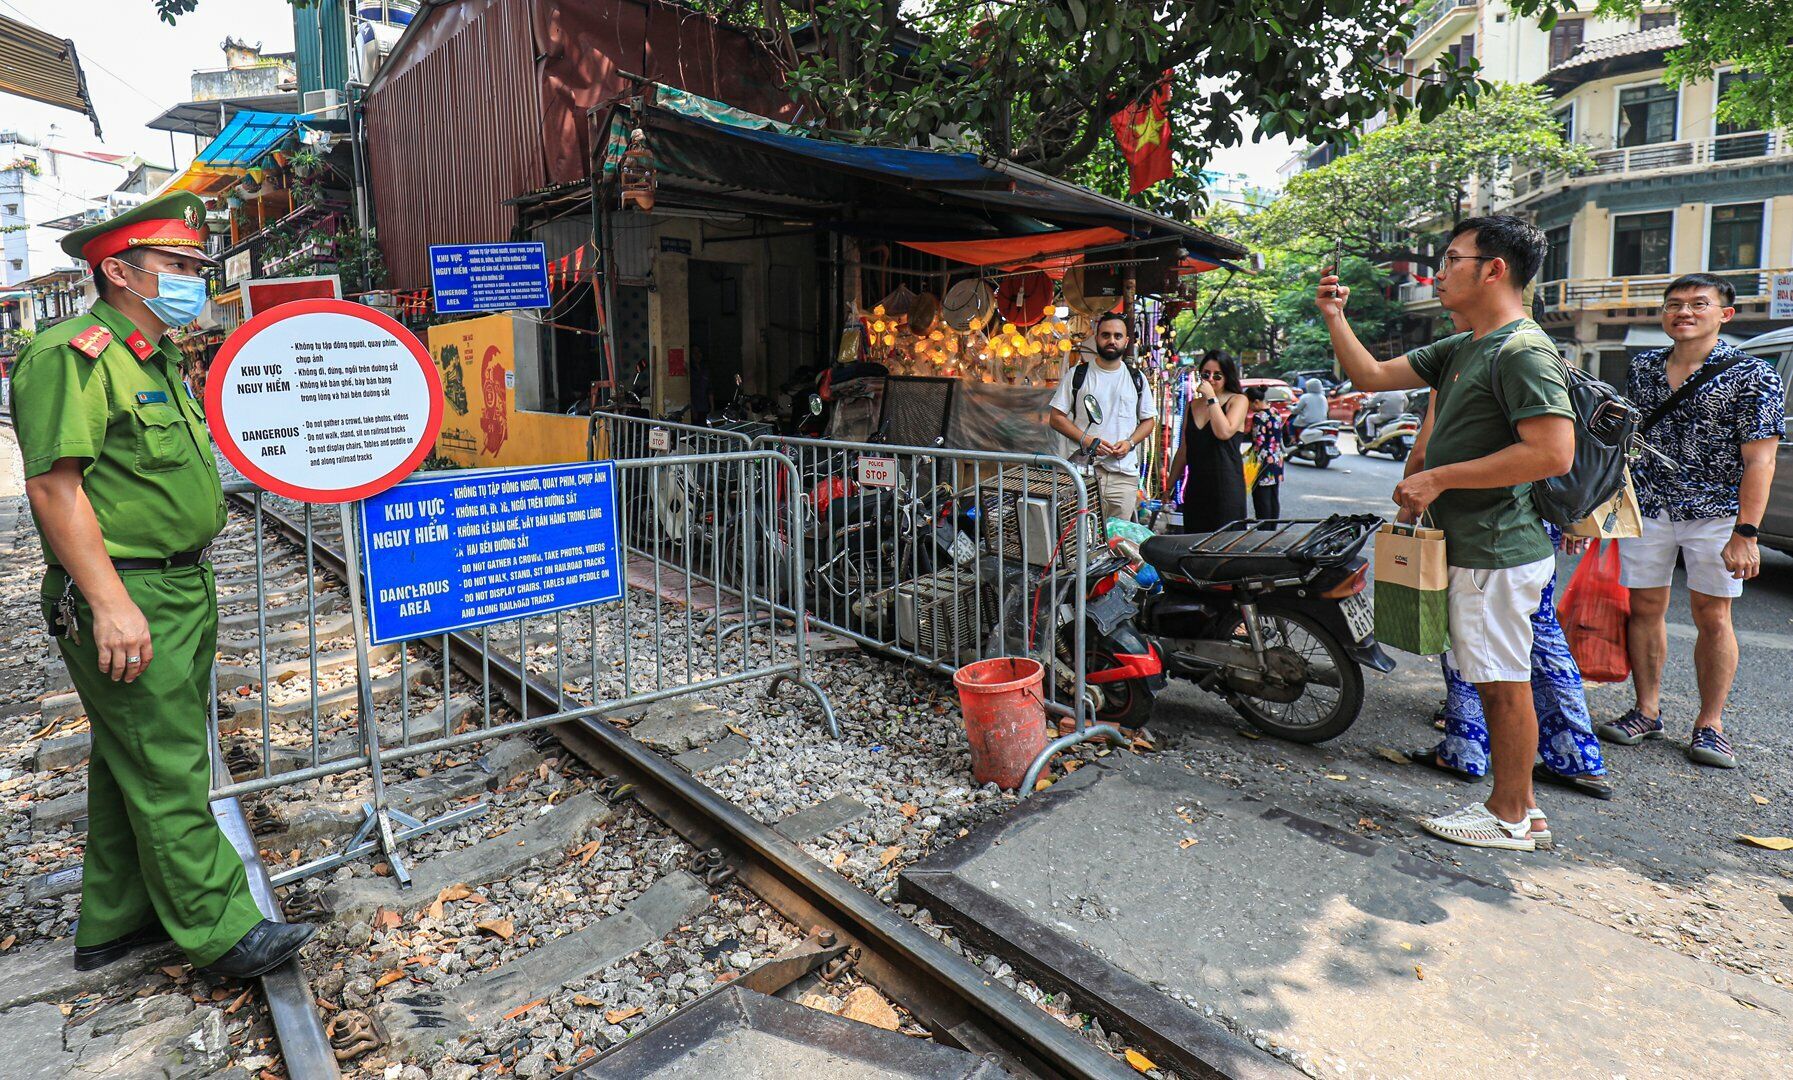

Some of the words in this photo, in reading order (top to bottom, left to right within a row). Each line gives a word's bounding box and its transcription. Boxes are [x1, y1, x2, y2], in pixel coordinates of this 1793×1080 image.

[241, 365, 261, 377] KHU
[263, 364, 282, 378] VỰC
[237, 382, 263, 395] NGUY
[266, 378, 291, 393] HIỂM
[306, 420, 313, 429] Do
[314, 420, 323, 428] not
[324, 419, 340, 428] gather
[346, 417, 363, 426] crowd,
[363, 416, 374, 424] take
[375, 415, 393, 424] photos,
[393, 413, 409, 421] videos
[242, 427, 300, 442] DANGEROUS
[307, 434, 315, 442] Do
[316, 433, 324, 441] not
[325, 431, 340, 440] walk,
[340, 430, 356, 438] stand,
[371, 427, 390, 436] railroad
[391, 425, 406, 434] tracks
[653, 438, 665, 446] STOP
[261, 445, 287, 457] AREA
[309, 446, 316, 454] Do
[317, 445, 326, 453] not
[327, 444, 345, 453] display
[346, 442, 364, 451] chairs,
[380, 439, 390, 447] and
[390, 438, 406, 447] peddle
[311, 458, 320, 467] and
[321, 458, 336, 466] along
[336, 454, 356, 464] railroad
[357, 453, 373, 462] tracks
[454, 485, 477, 500] KHÔNG
[478, 485, 487, 499] TỤ
[488, 481, 500, 498] TẬP
[501, 480, 520, 494] ĐÔNG
[520, 477, 542, 492] NGƯỜI,
[542, 477, 558, 491] QUAY
[560, 475, 577, 487] PHIM,
[578, 473, 593, 487] CHỤP
[594, 468, 607, 483] ẢNH
[865, 470, 888, 481] STOP
[385, 502, 414, 522] KHU
[418, 498, 446, 520] VỰC
[456, 504, 479, 519] KHÔNG
[511, 496, 527, 512] NGỒI
[528, 495, 543, 510] TRÊN
[544, 493, 565, 508] ĐƯỜNG
[566, 490, 578, 505] SẮT
[457, 523, 481, 538] KHÔNG
[492, 520, 506, 534] BÀN
[507, 516, 522, 531] GHẾ,
[549, 512, 566, 526] HÀNG
[567, 509, 586, 523] TRONG
[373, 529, 411, 550] NGUY
[415, 519, 449, 544] HIỂM
[480, 540, 493, 554] BÊN
[494, 537, 516, 552] ĐƯỜNG
[517, 532, 529, 549] SẮT
[462, 564, 472, 574] DO
[473, 562, 486, 572] NOT
[487, 558, 512, 570] GATHER
[513, 557, 518, 566] A
[544, 550, 560, 561] TAKE
[561, 546, 585, 558] PHOTOS,
[585, 543, 606, 554] VIDEOS
[464, 579, 473, 589] DO
[474, 576, 487, 587] NOT
[510, 569, 533, 581] STAND,
[545, 565, 554, 575] ON
[584, 556, 606, 568] TRACKS
[475, 591, 489, 602] NOT
[490, 586, 516, 599] DISPLAY
[517, 582, 542, 594] CHAIRS,
[566, 575, 579, 586] AND
[579, 571, 600, 583] PEDDLE
[601, 569, 610, 579] ON
[400, 600, 432, 618] AREA
[461, 608, 476, 619] AND
[477, 604, 499, 616] ALONG
[531, 594, 555, 606] TRACKS
